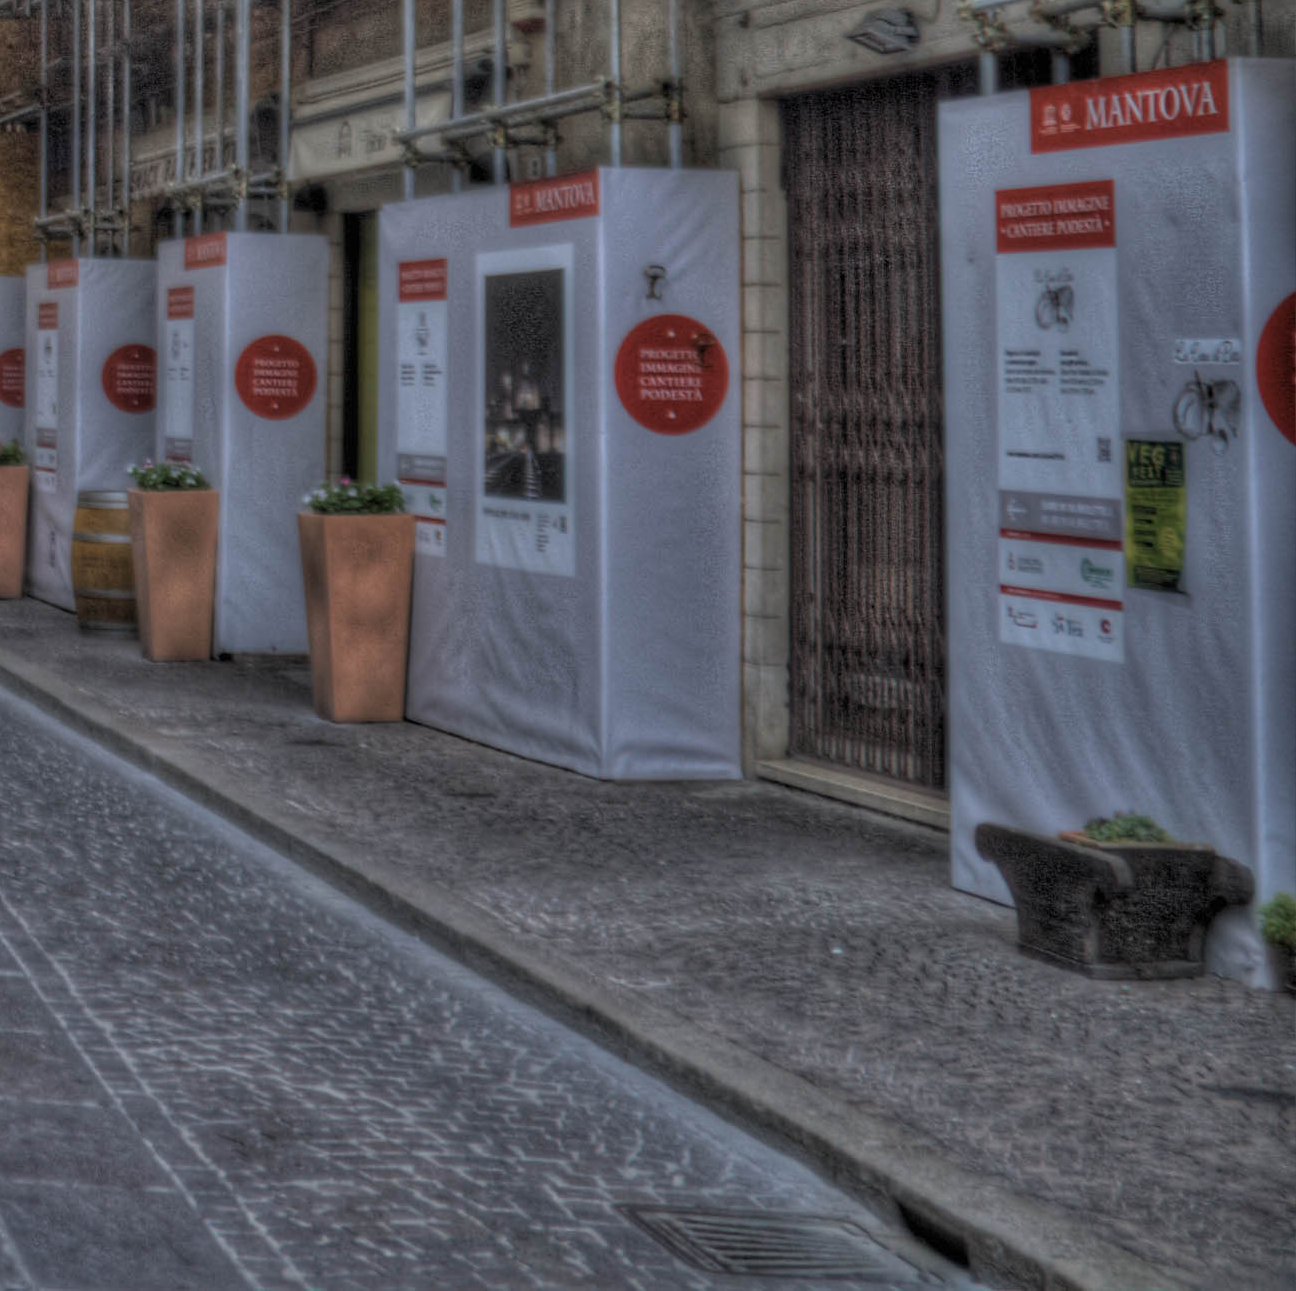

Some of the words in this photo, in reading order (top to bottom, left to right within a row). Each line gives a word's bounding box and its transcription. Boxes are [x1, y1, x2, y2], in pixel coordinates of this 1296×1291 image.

[1085, 81, 1219, 130] MANTOVA
[535, 182, 596, 213] MANTOVA
[1001, 200, 1052, 218] PROGETTO
[639, 375, 704, 387] CANTIERE
